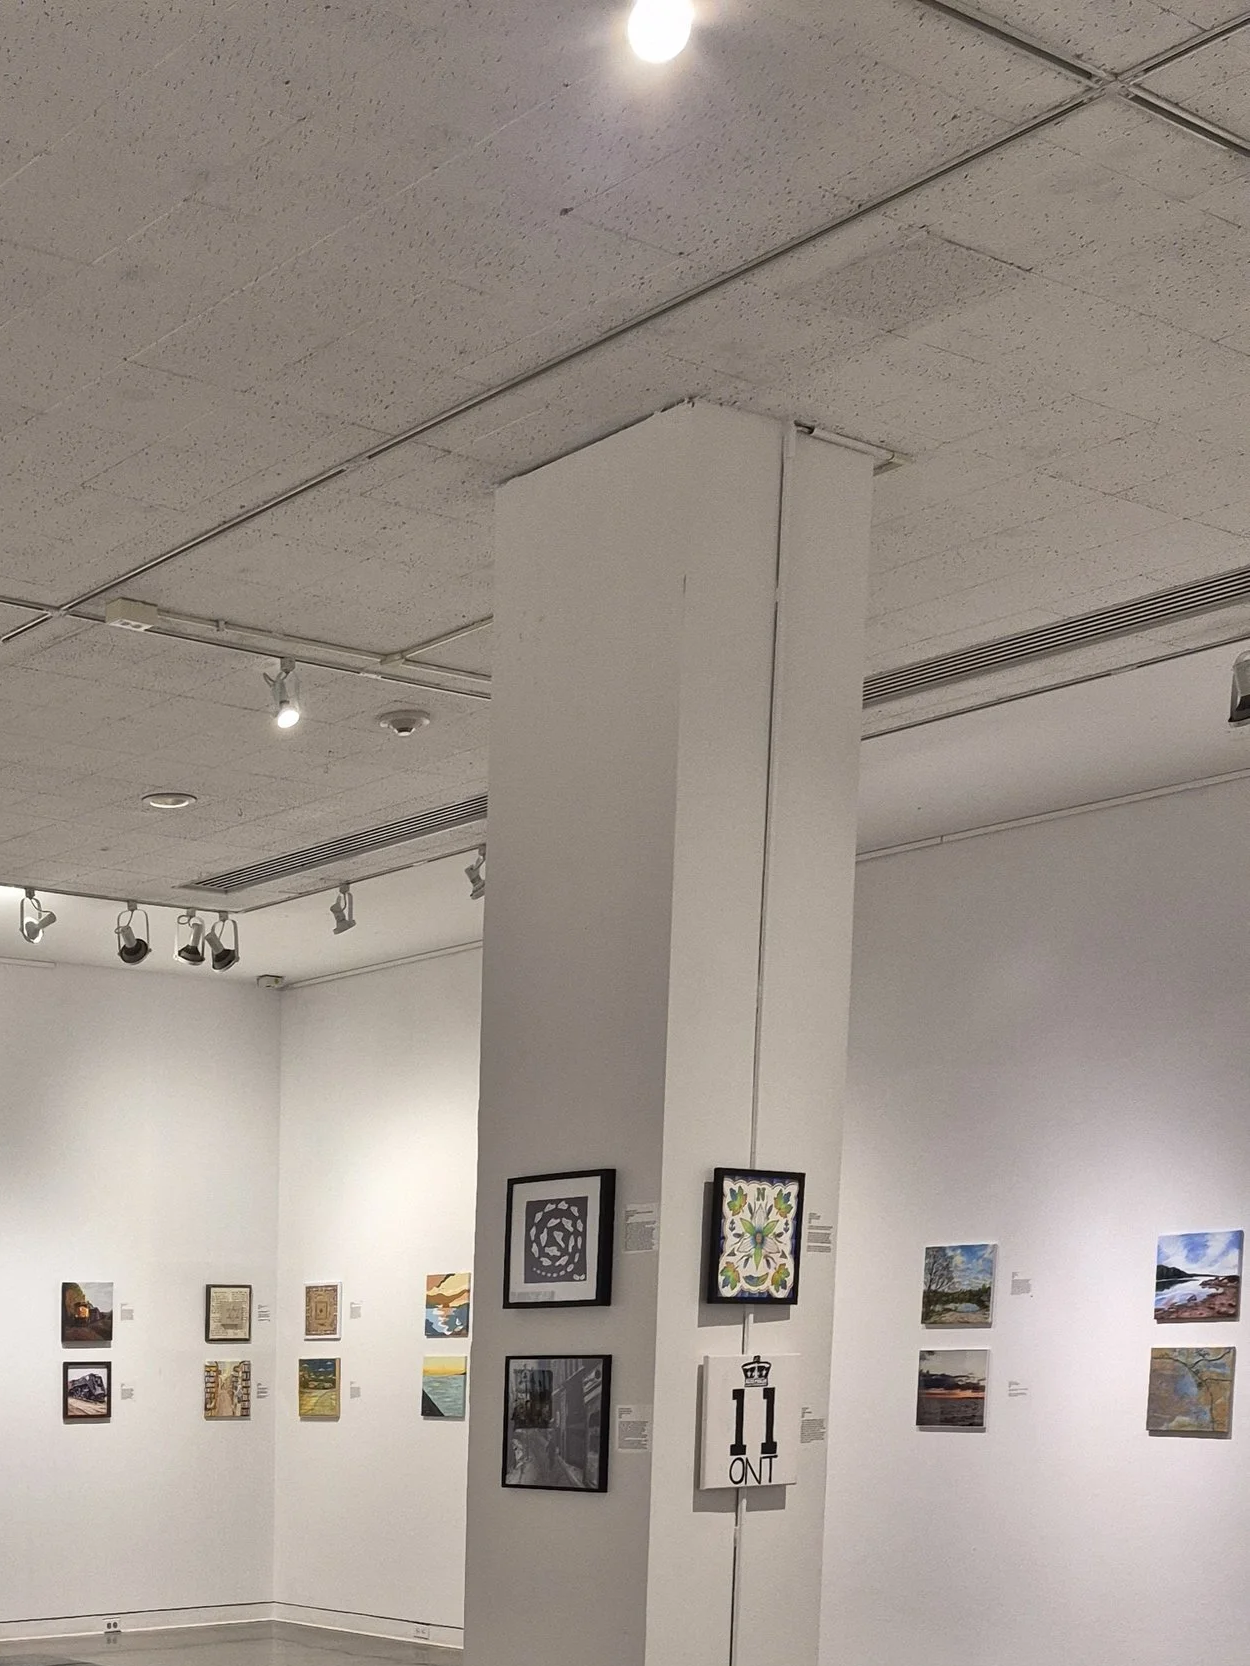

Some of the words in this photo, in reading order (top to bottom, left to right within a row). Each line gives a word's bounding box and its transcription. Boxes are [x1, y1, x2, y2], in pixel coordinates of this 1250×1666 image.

[756, 1187, 766, 1202] N
[730, 1387, 777, 1456] 11
[729, 1455, 778, 1485] ONT
